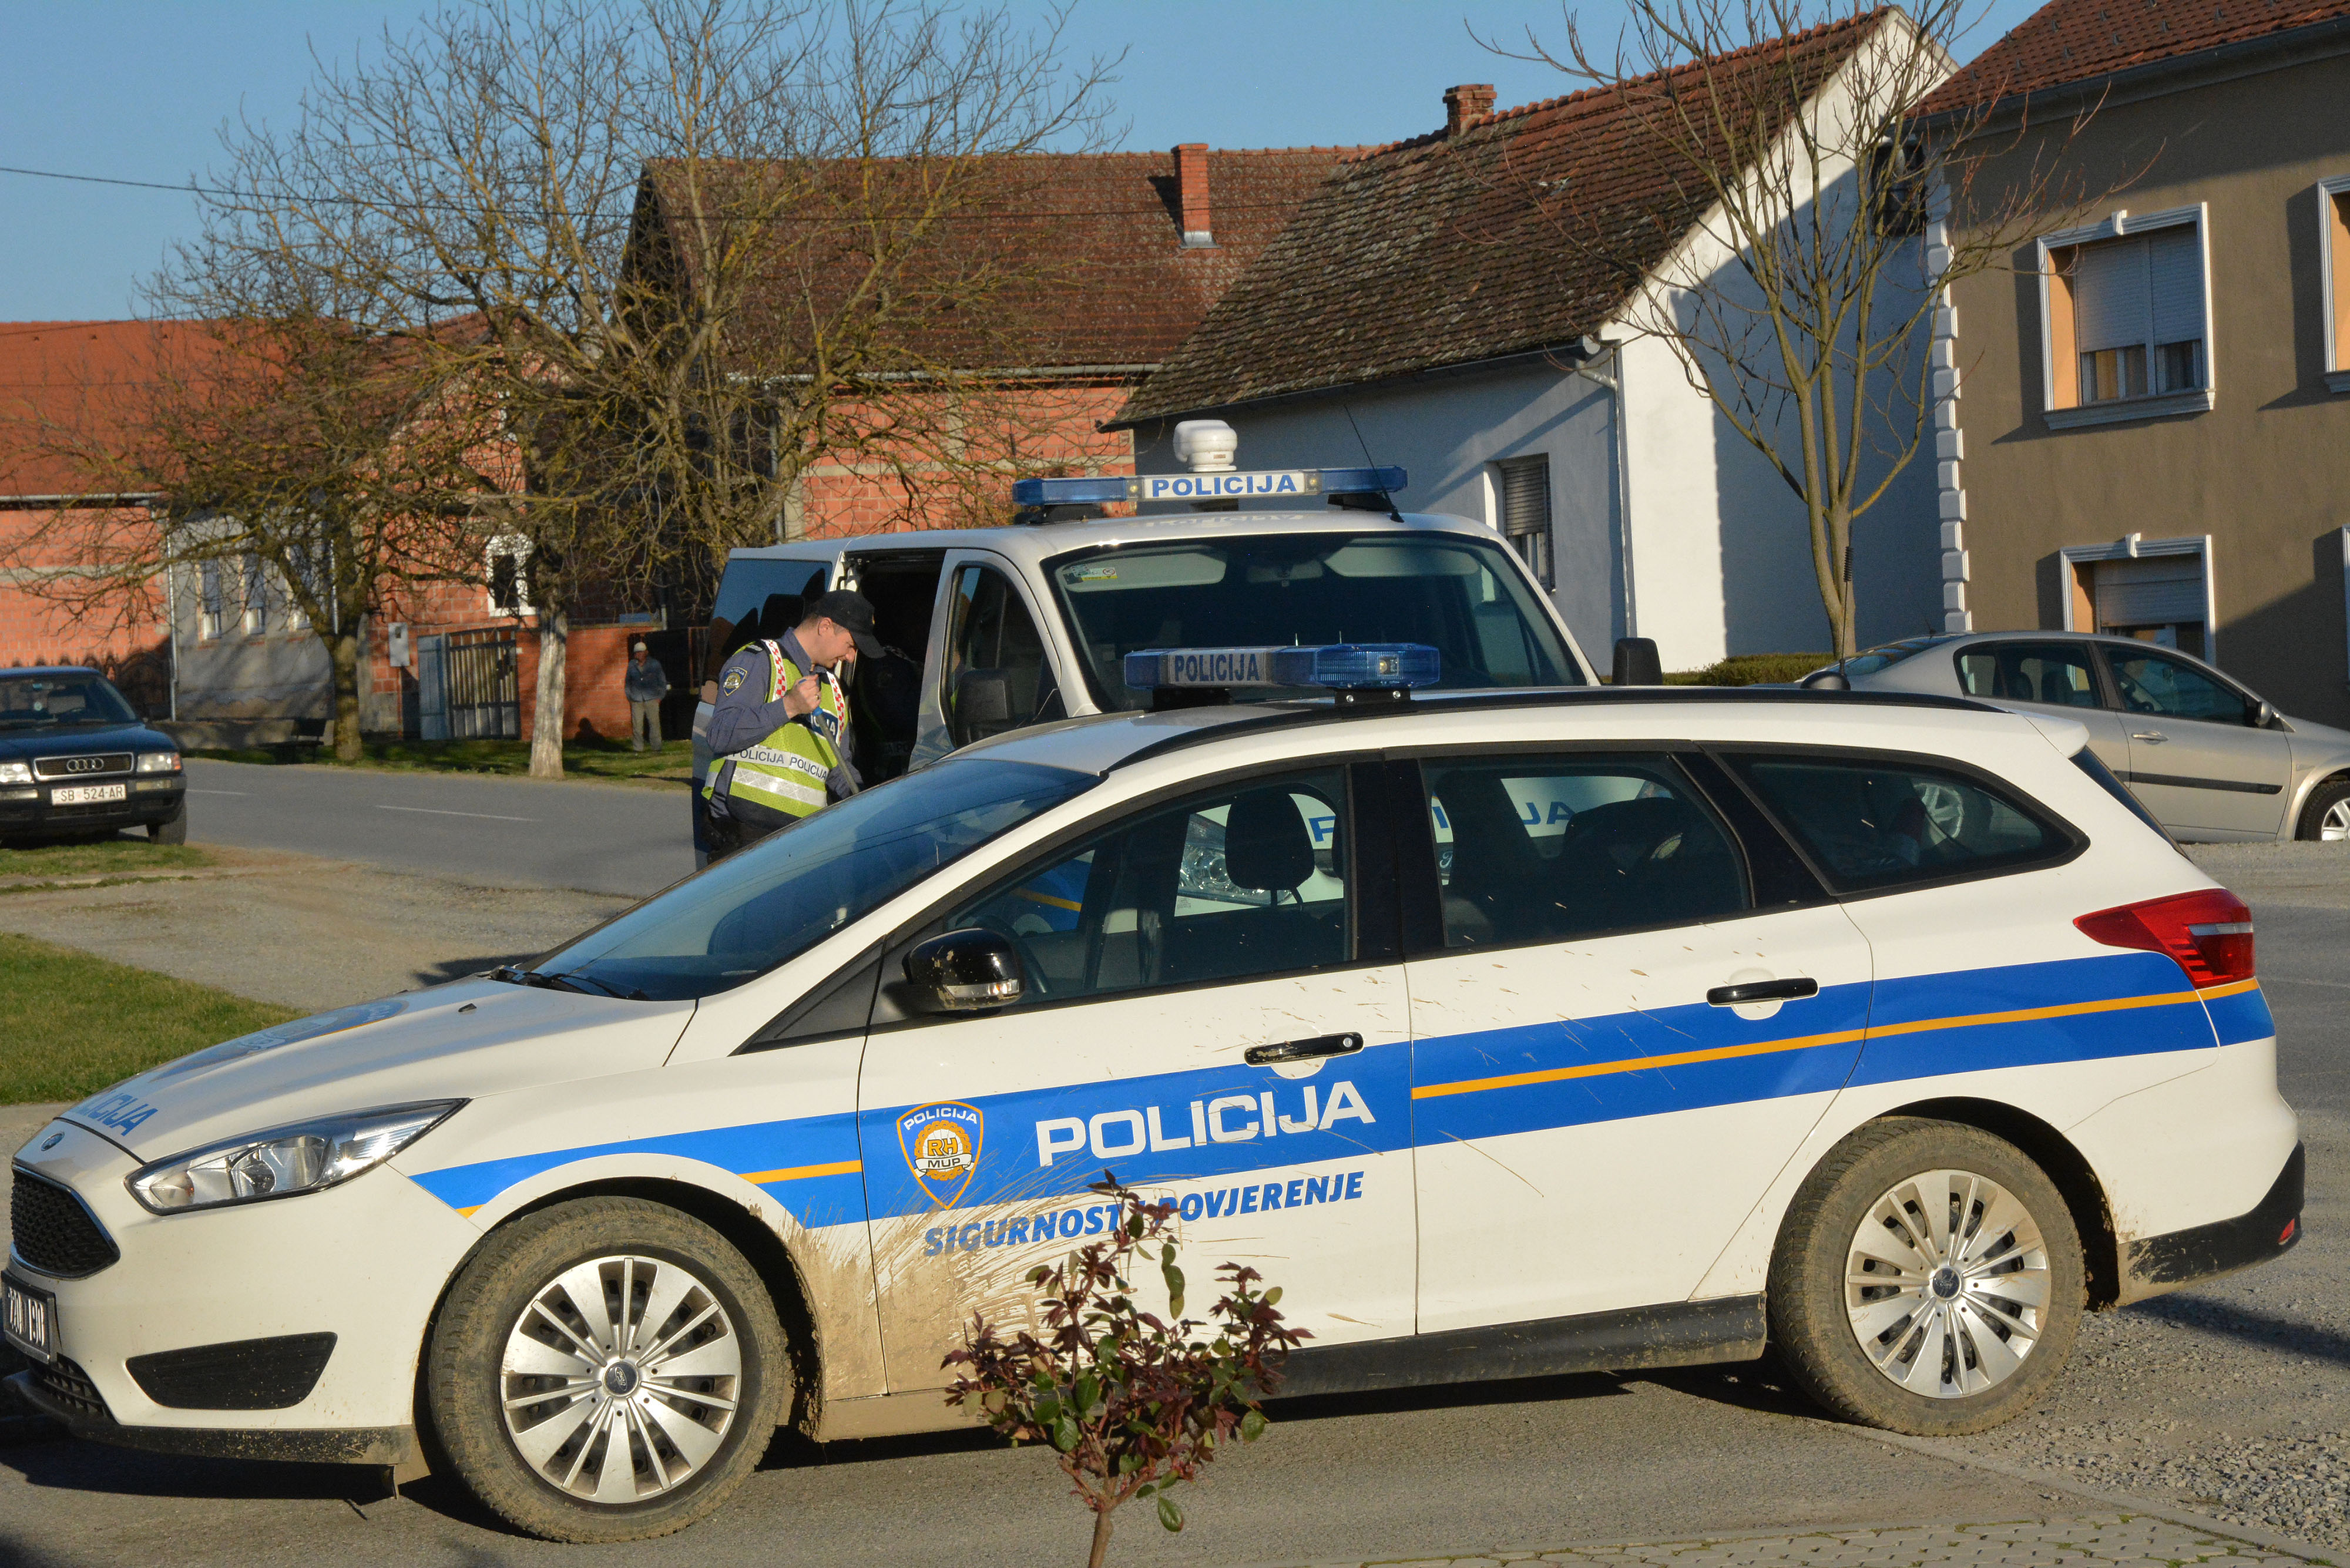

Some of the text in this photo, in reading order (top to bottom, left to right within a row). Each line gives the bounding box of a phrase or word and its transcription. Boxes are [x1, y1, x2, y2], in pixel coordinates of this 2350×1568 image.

[1152, 474, 1297, 497] POLICIJA
[1174, 653, 1260, 681] POLICIJA
[733, 749, 828, 780] OLICIJA POLICIJA
[61, 790, 75, 801] SB
[904, 1107, 978, 1131] POLICIJA
[1036, 1080, 1376, 1167] POLICIJA
[927, 1137, 959, 1157] RH
[928, 1157, 961, 1168] MUP
[924, 1202, 1125, 1257] SIGURNOST
